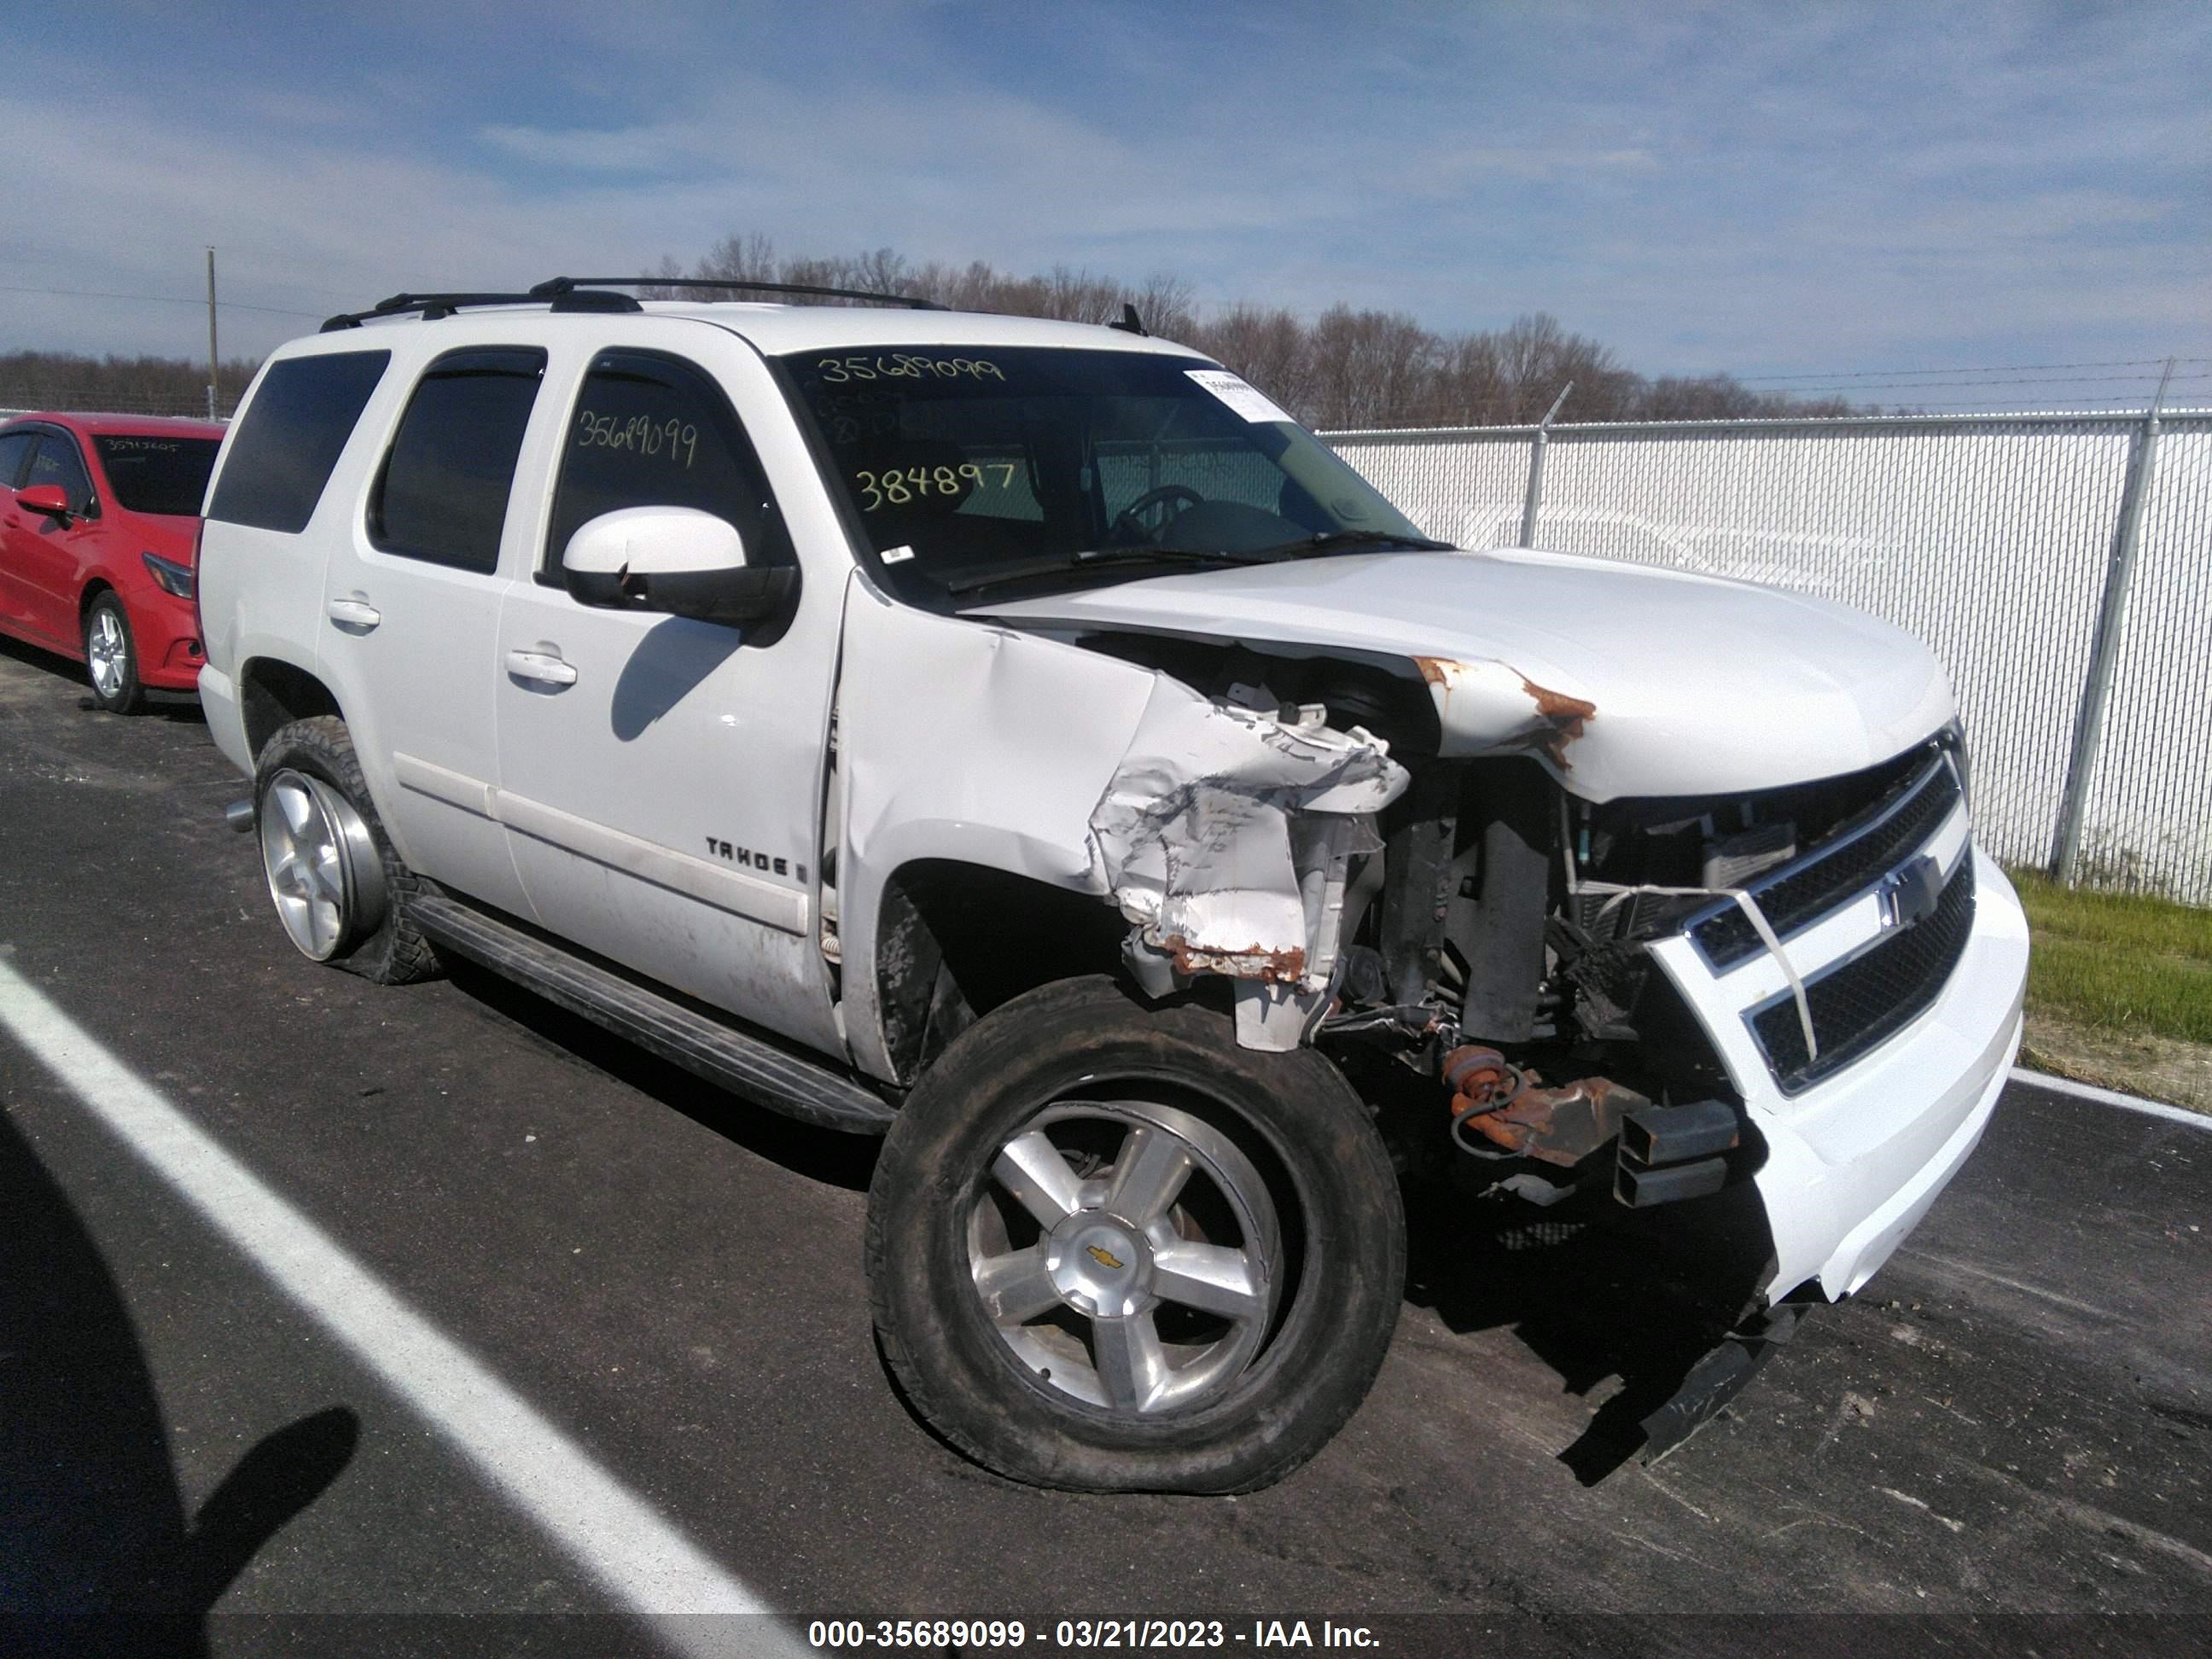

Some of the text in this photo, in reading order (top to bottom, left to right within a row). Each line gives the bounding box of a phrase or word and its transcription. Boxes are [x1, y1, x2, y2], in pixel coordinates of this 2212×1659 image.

[818, 353, 1006, 381] 35689099
[579, 410, 696, 469] 35689099
[856, 463, 1015, 511] 384897
[706, 836, 788, 876] TAHOE
